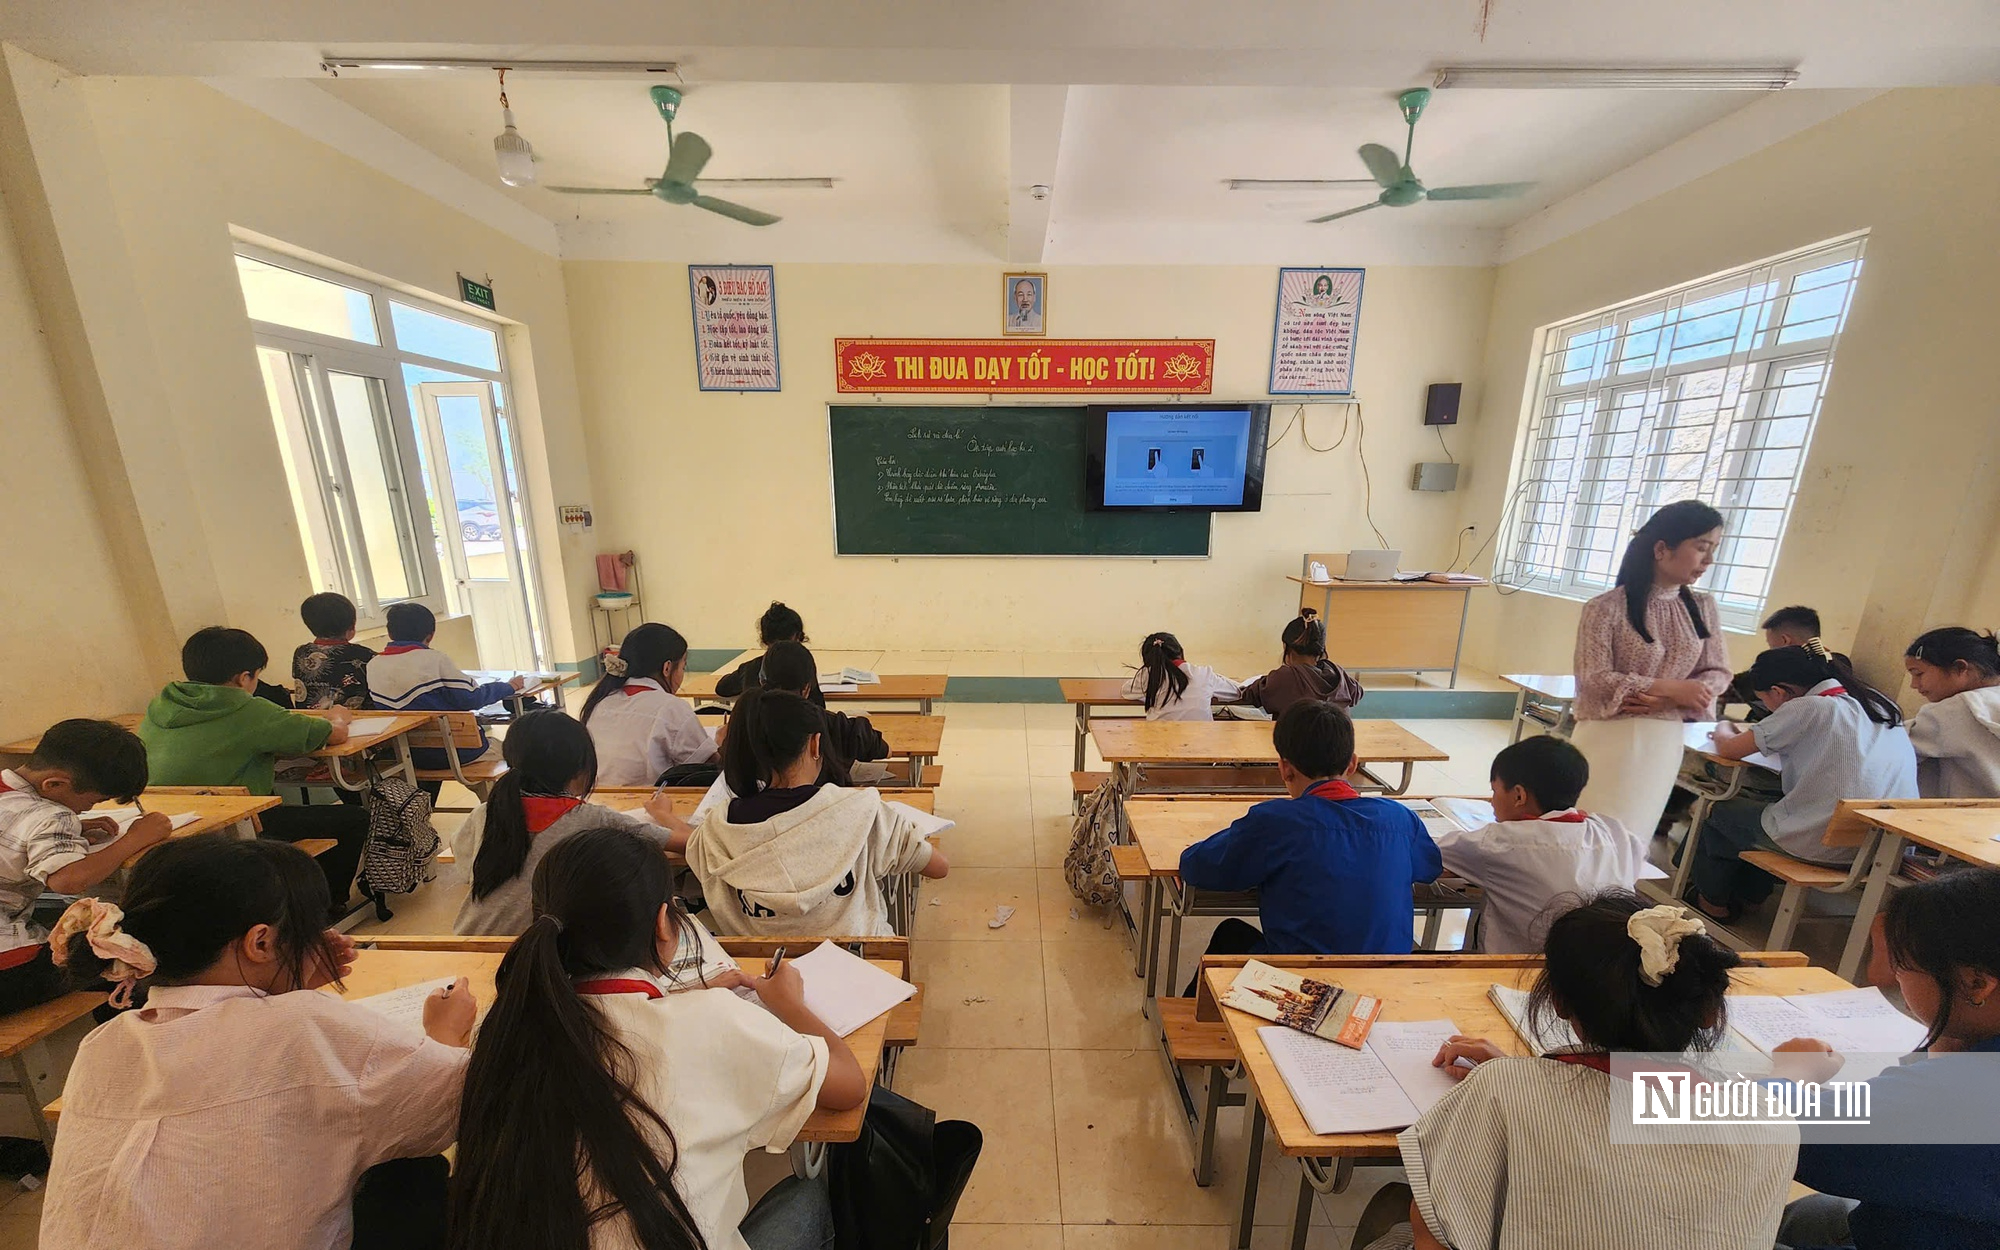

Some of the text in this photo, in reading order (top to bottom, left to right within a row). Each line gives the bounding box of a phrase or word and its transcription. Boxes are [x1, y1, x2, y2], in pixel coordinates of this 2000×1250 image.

[468, 283, 489, 300] EXIT
[718, 281, 723, 295] 5
[894, 355, 924, 380] THI
[929, 355, 969, 380] ĐUA
[974, 355, 1012, 385] DẠY
[1016, 348, 1051, 380] TỐT
[1070, 355, 1108, 385] HỌC
[1115, 348, 1155, 380] TỐT!
